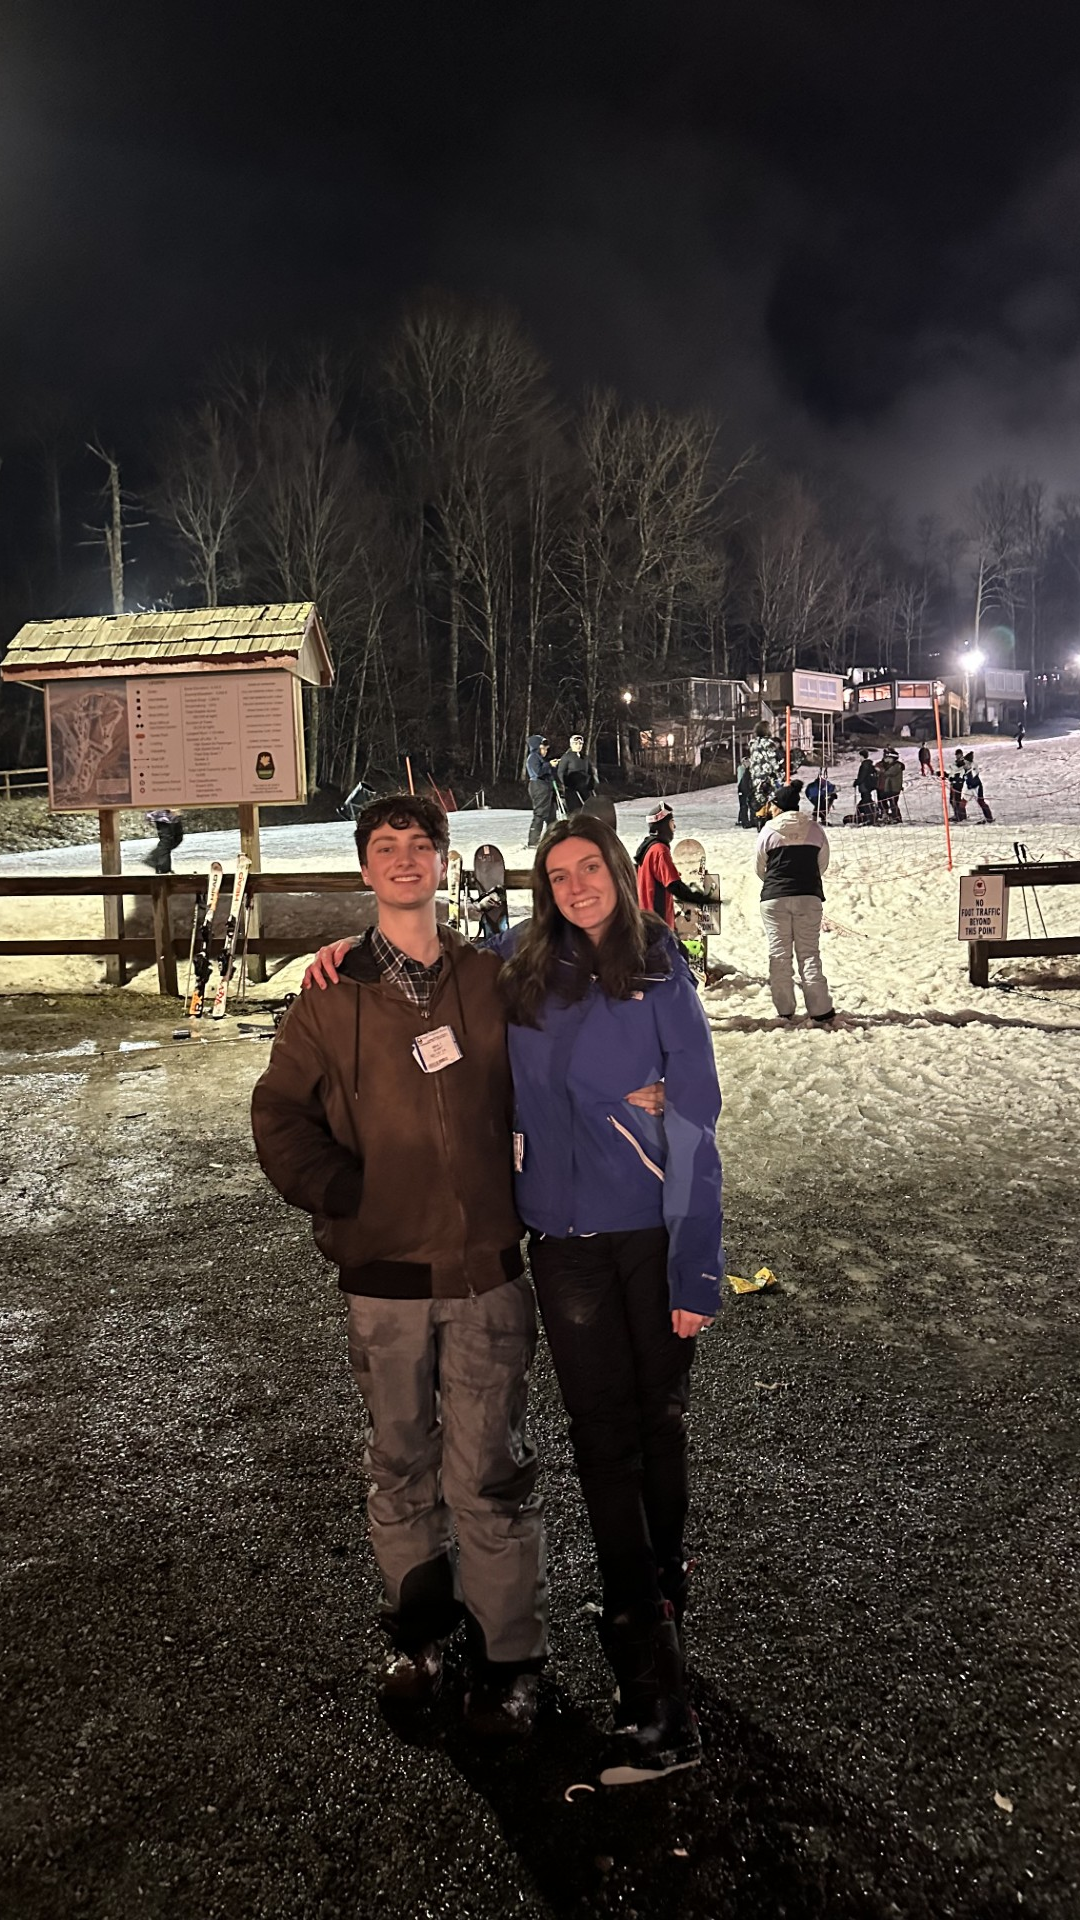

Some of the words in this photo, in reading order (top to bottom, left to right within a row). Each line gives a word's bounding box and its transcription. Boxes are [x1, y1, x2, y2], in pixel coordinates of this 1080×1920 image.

[209, 874, 218, 901] HEAD
[234, 872, 244, 902] HEAD
[975, 899, 984, 907] NO
[961, 908, 974, 917] FOOT
[976, 908, 1001, 916] TRAFFIC
[969, 917, 991, 926] BEYOND
[965, 927, 977, 935] THIS
[978, 926, 996, 935] POINT
